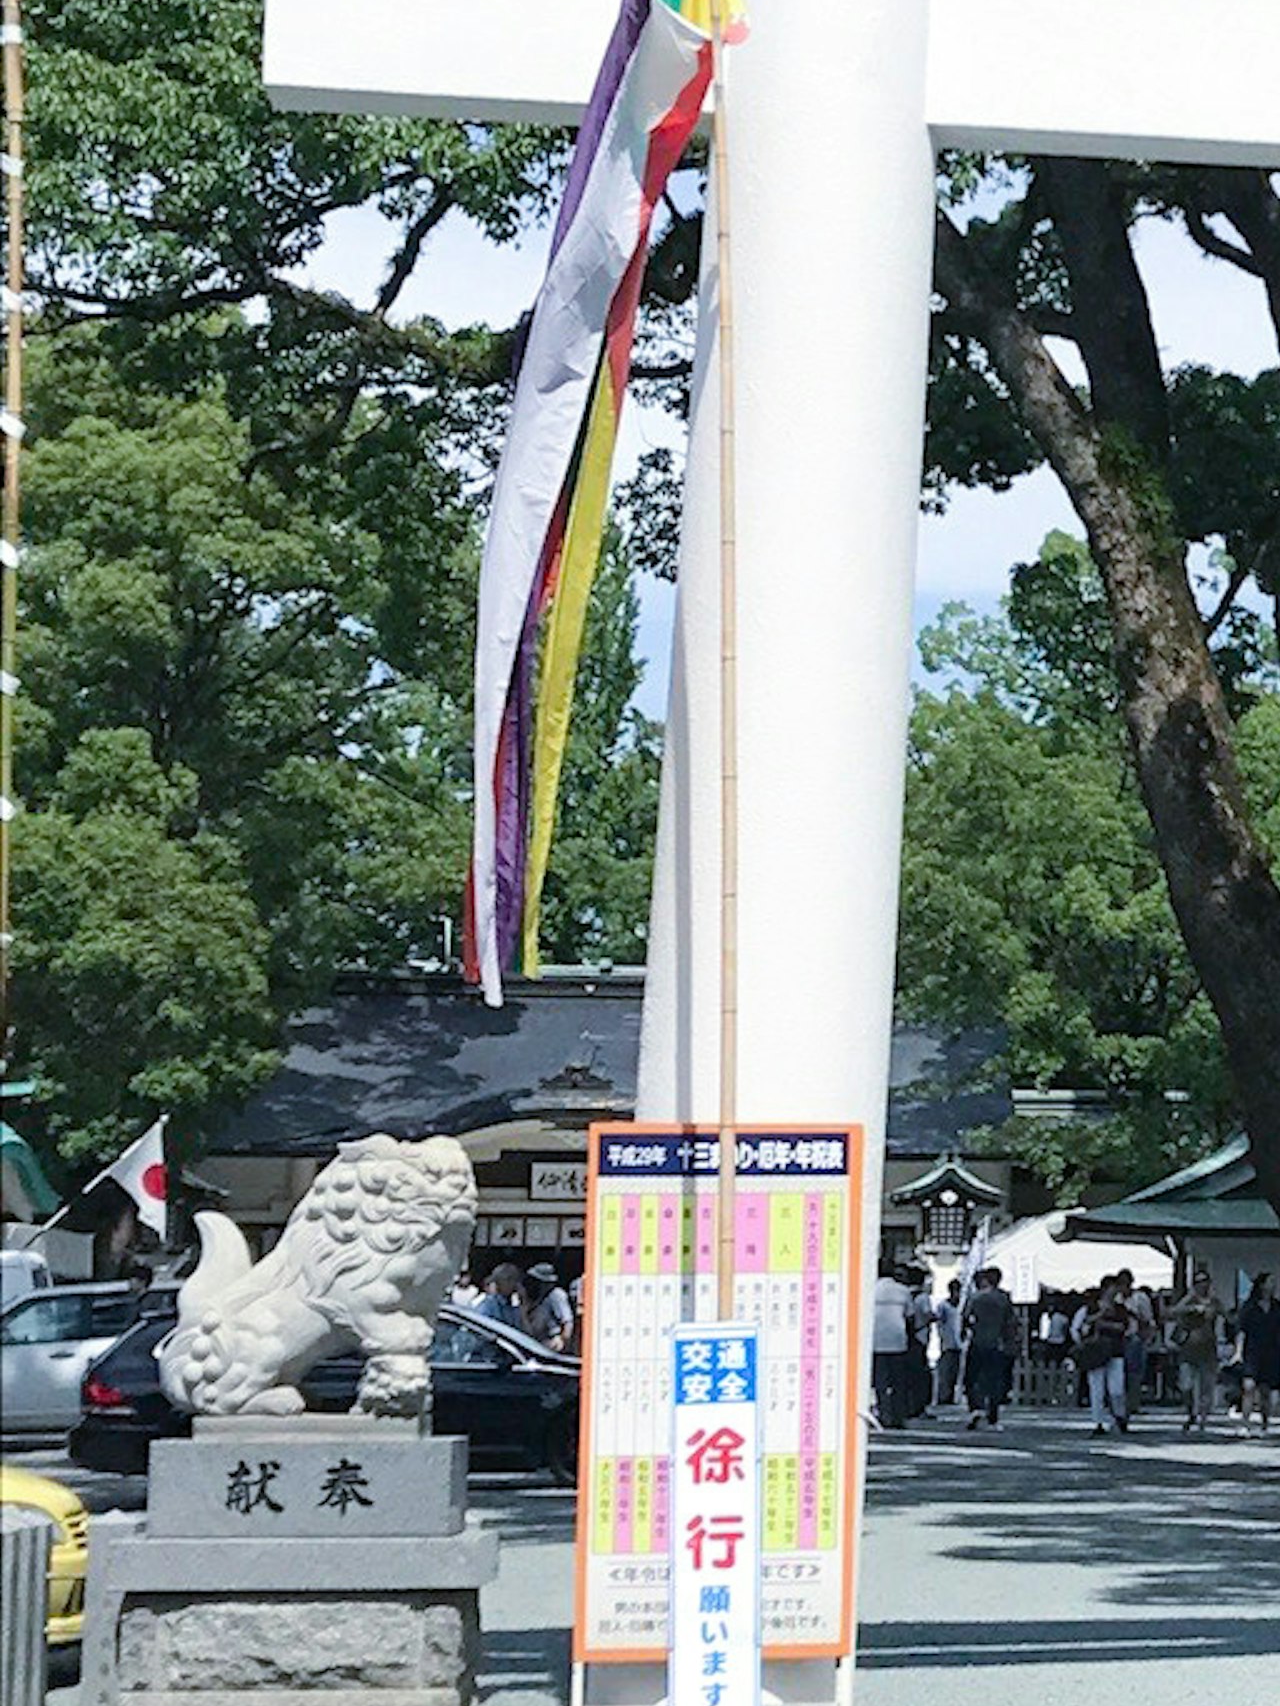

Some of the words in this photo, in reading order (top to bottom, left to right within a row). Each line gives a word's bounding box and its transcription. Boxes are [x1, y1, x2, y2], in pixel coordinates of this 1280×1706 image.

[607, 1143, 668, 1168] 平成29年
[682, 1340, 749, 1370] 交通
[682, 1372, 749, 1403] 安全
[685, 1426, 746, 1571] 徐行
